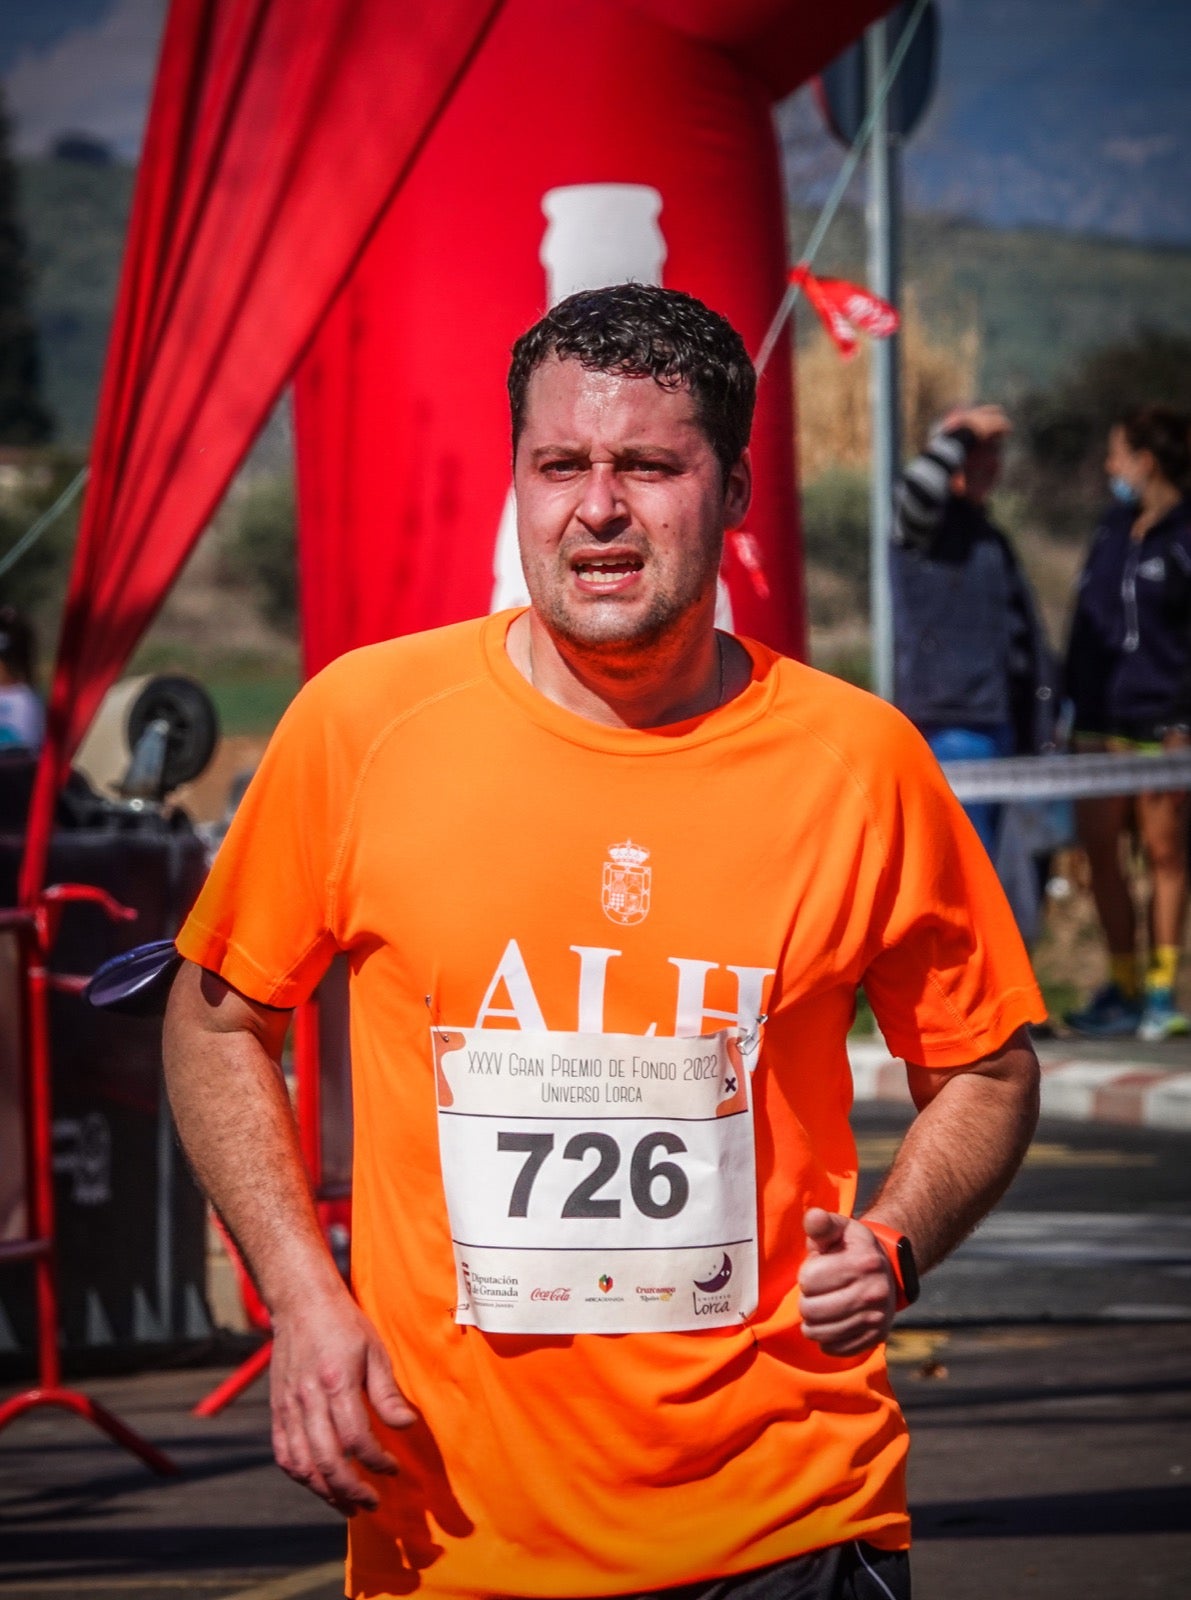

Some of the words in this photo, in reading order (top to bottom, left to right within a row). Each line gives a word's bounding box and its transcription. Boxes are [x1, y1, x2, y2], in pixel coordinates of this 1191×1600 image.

[467, 1050, 503, 1075] XXXV
[683, 1054, 719, 1081] 2022
[497, 1131, 690, 1219] 726
[480, 1284, 519, 1297] Granada
